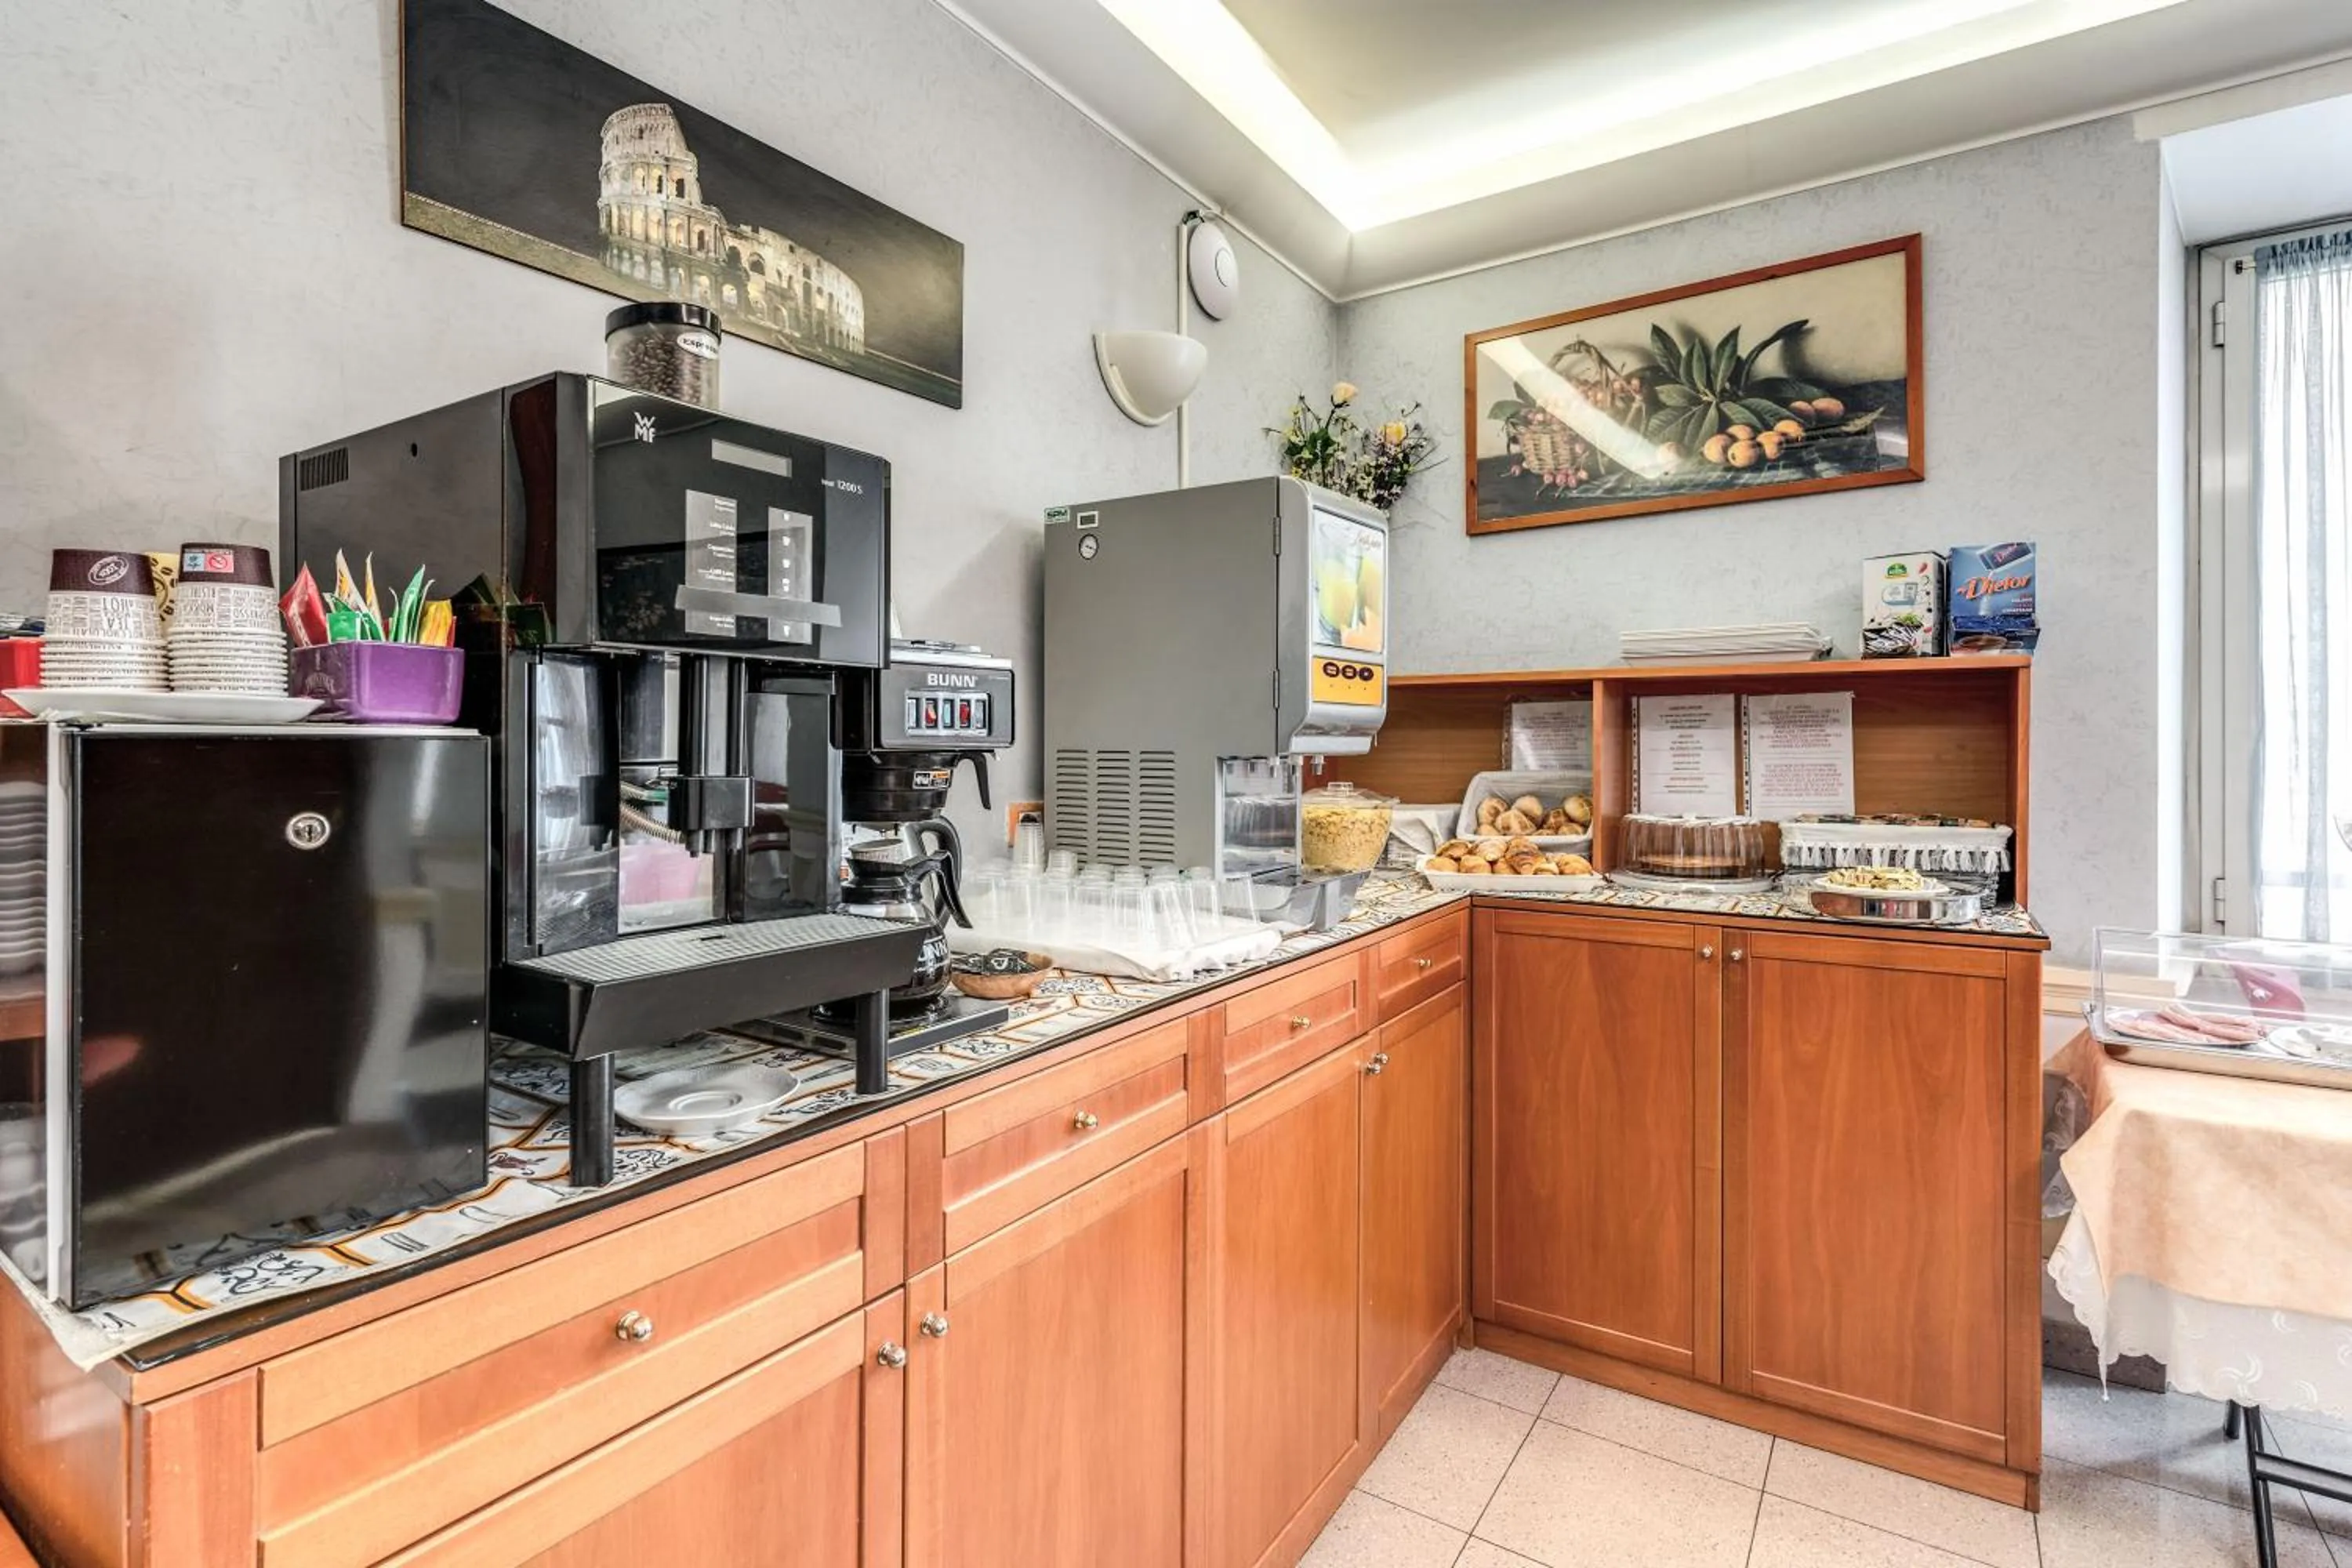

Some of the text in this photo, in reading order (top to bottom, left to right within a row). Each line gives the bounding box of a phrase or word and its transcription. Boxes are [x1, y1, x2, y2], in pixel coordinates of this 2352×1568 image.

[683, 338, 719, 354] Esprsso
[837, 479, 857, 493] 1200
[1957, 573, 2031, 601] Dietor
[927, 673, 975, 688] BUNN
